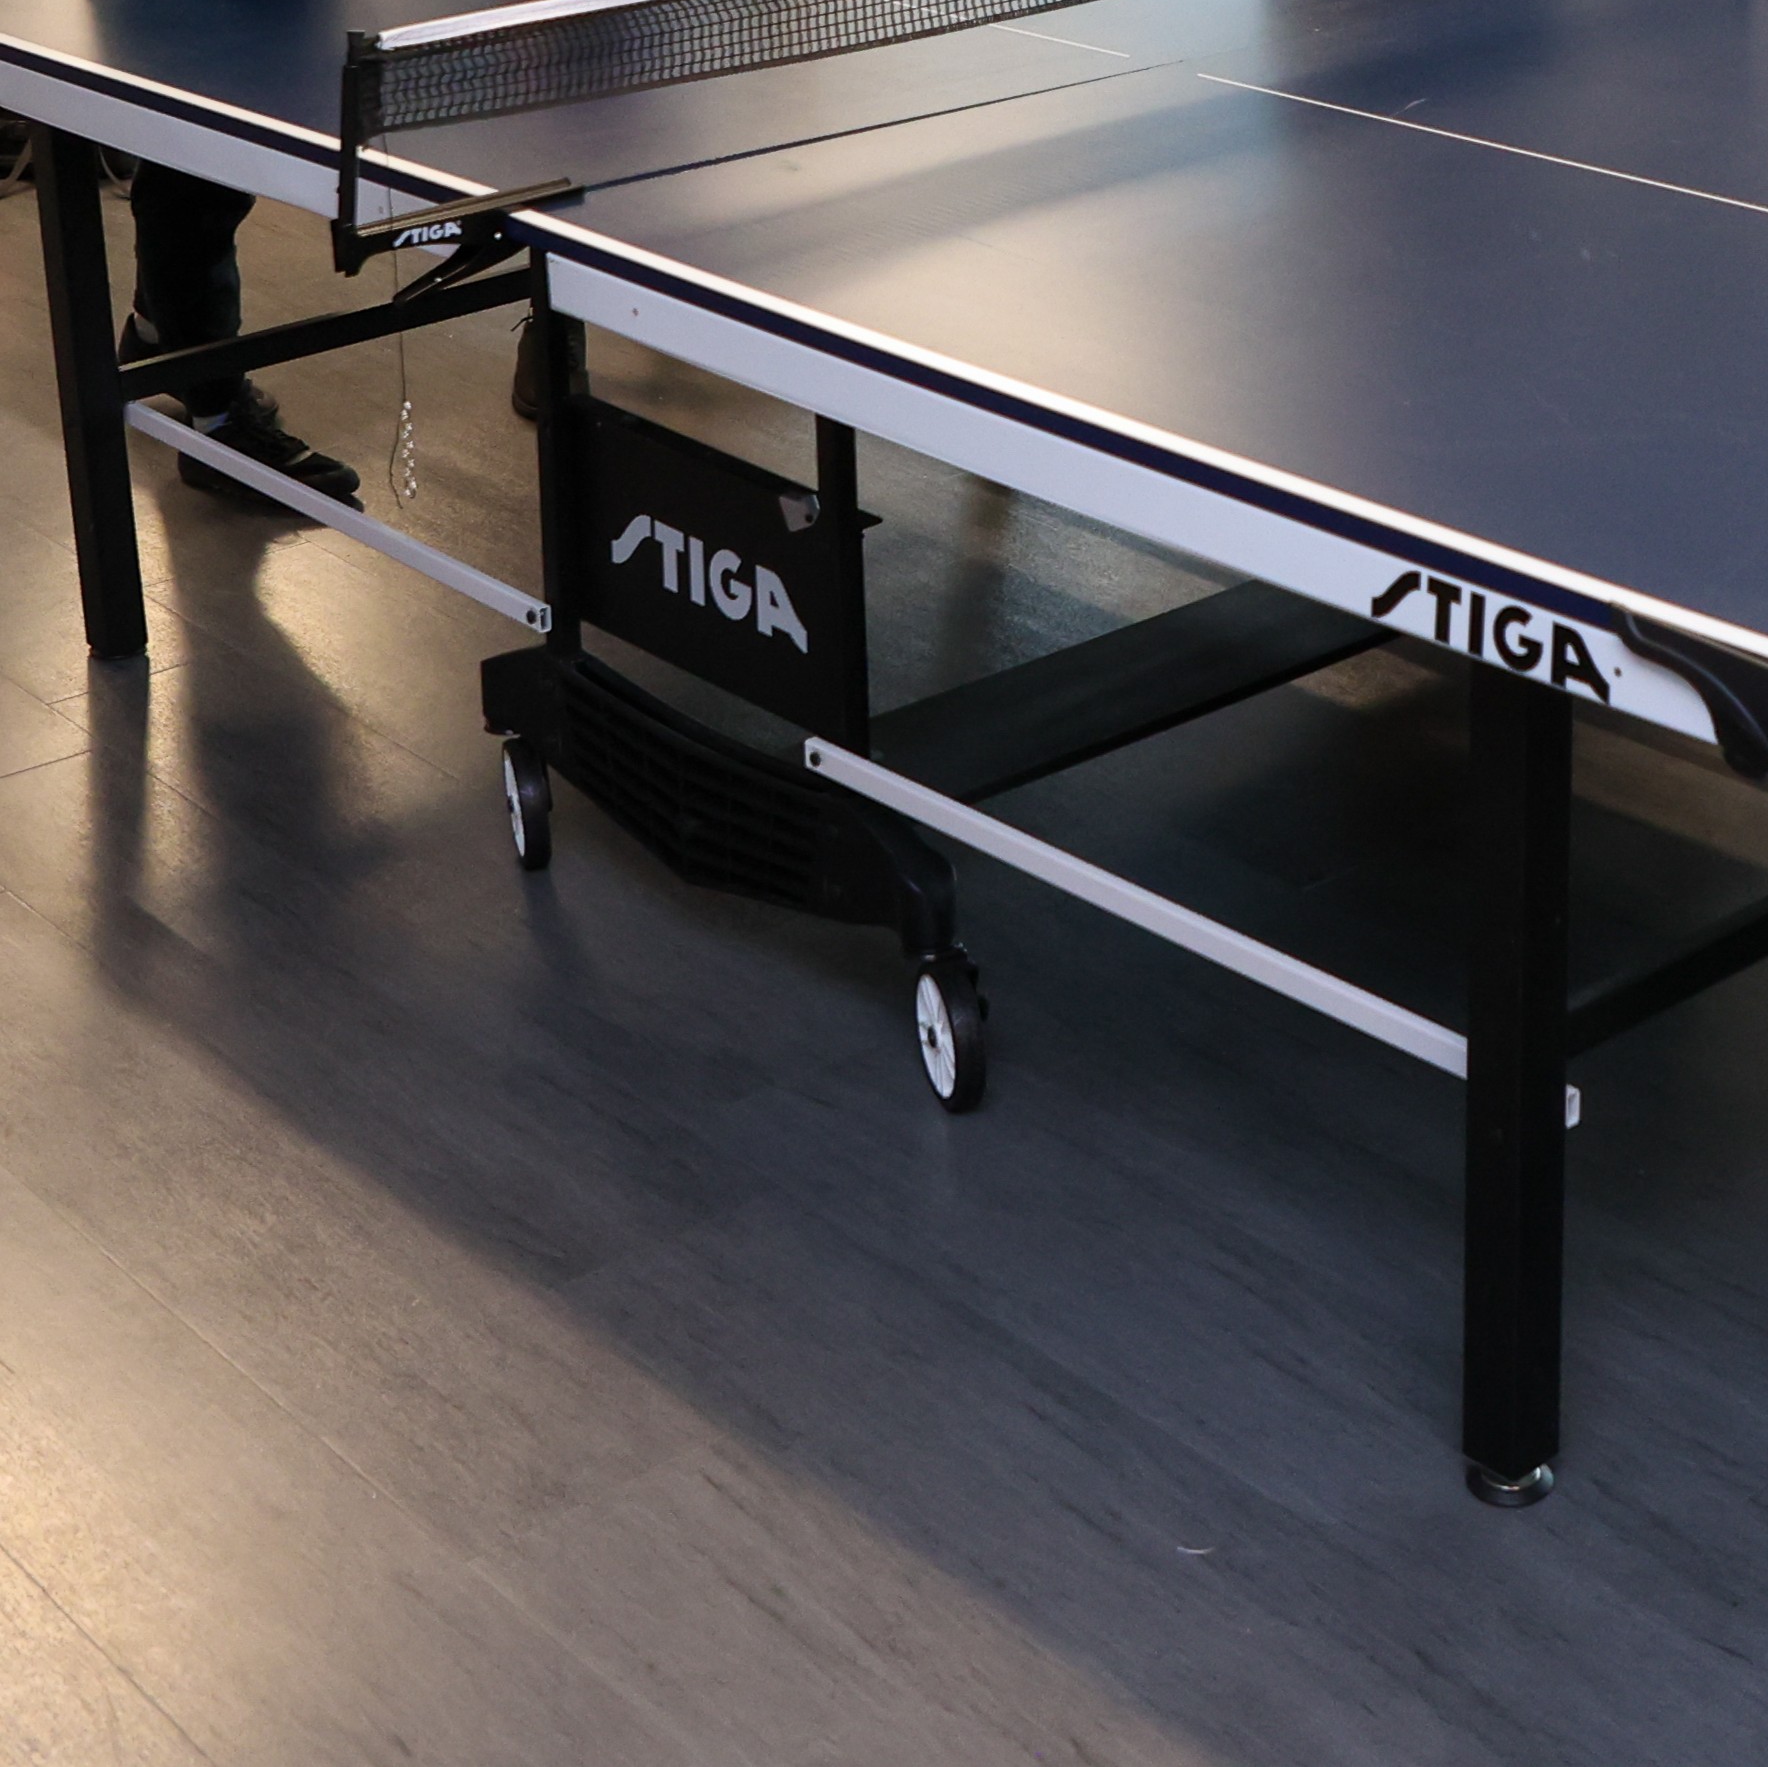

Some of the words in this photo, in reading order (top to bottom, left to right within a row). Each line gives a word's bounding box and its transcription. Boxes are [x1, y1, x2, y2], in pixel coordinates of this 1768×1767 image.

[392, 221, 462, 247] STIGA
[611, 514, 808, 654] STIGA
[1371, 570, 1610, 705] STIGA
